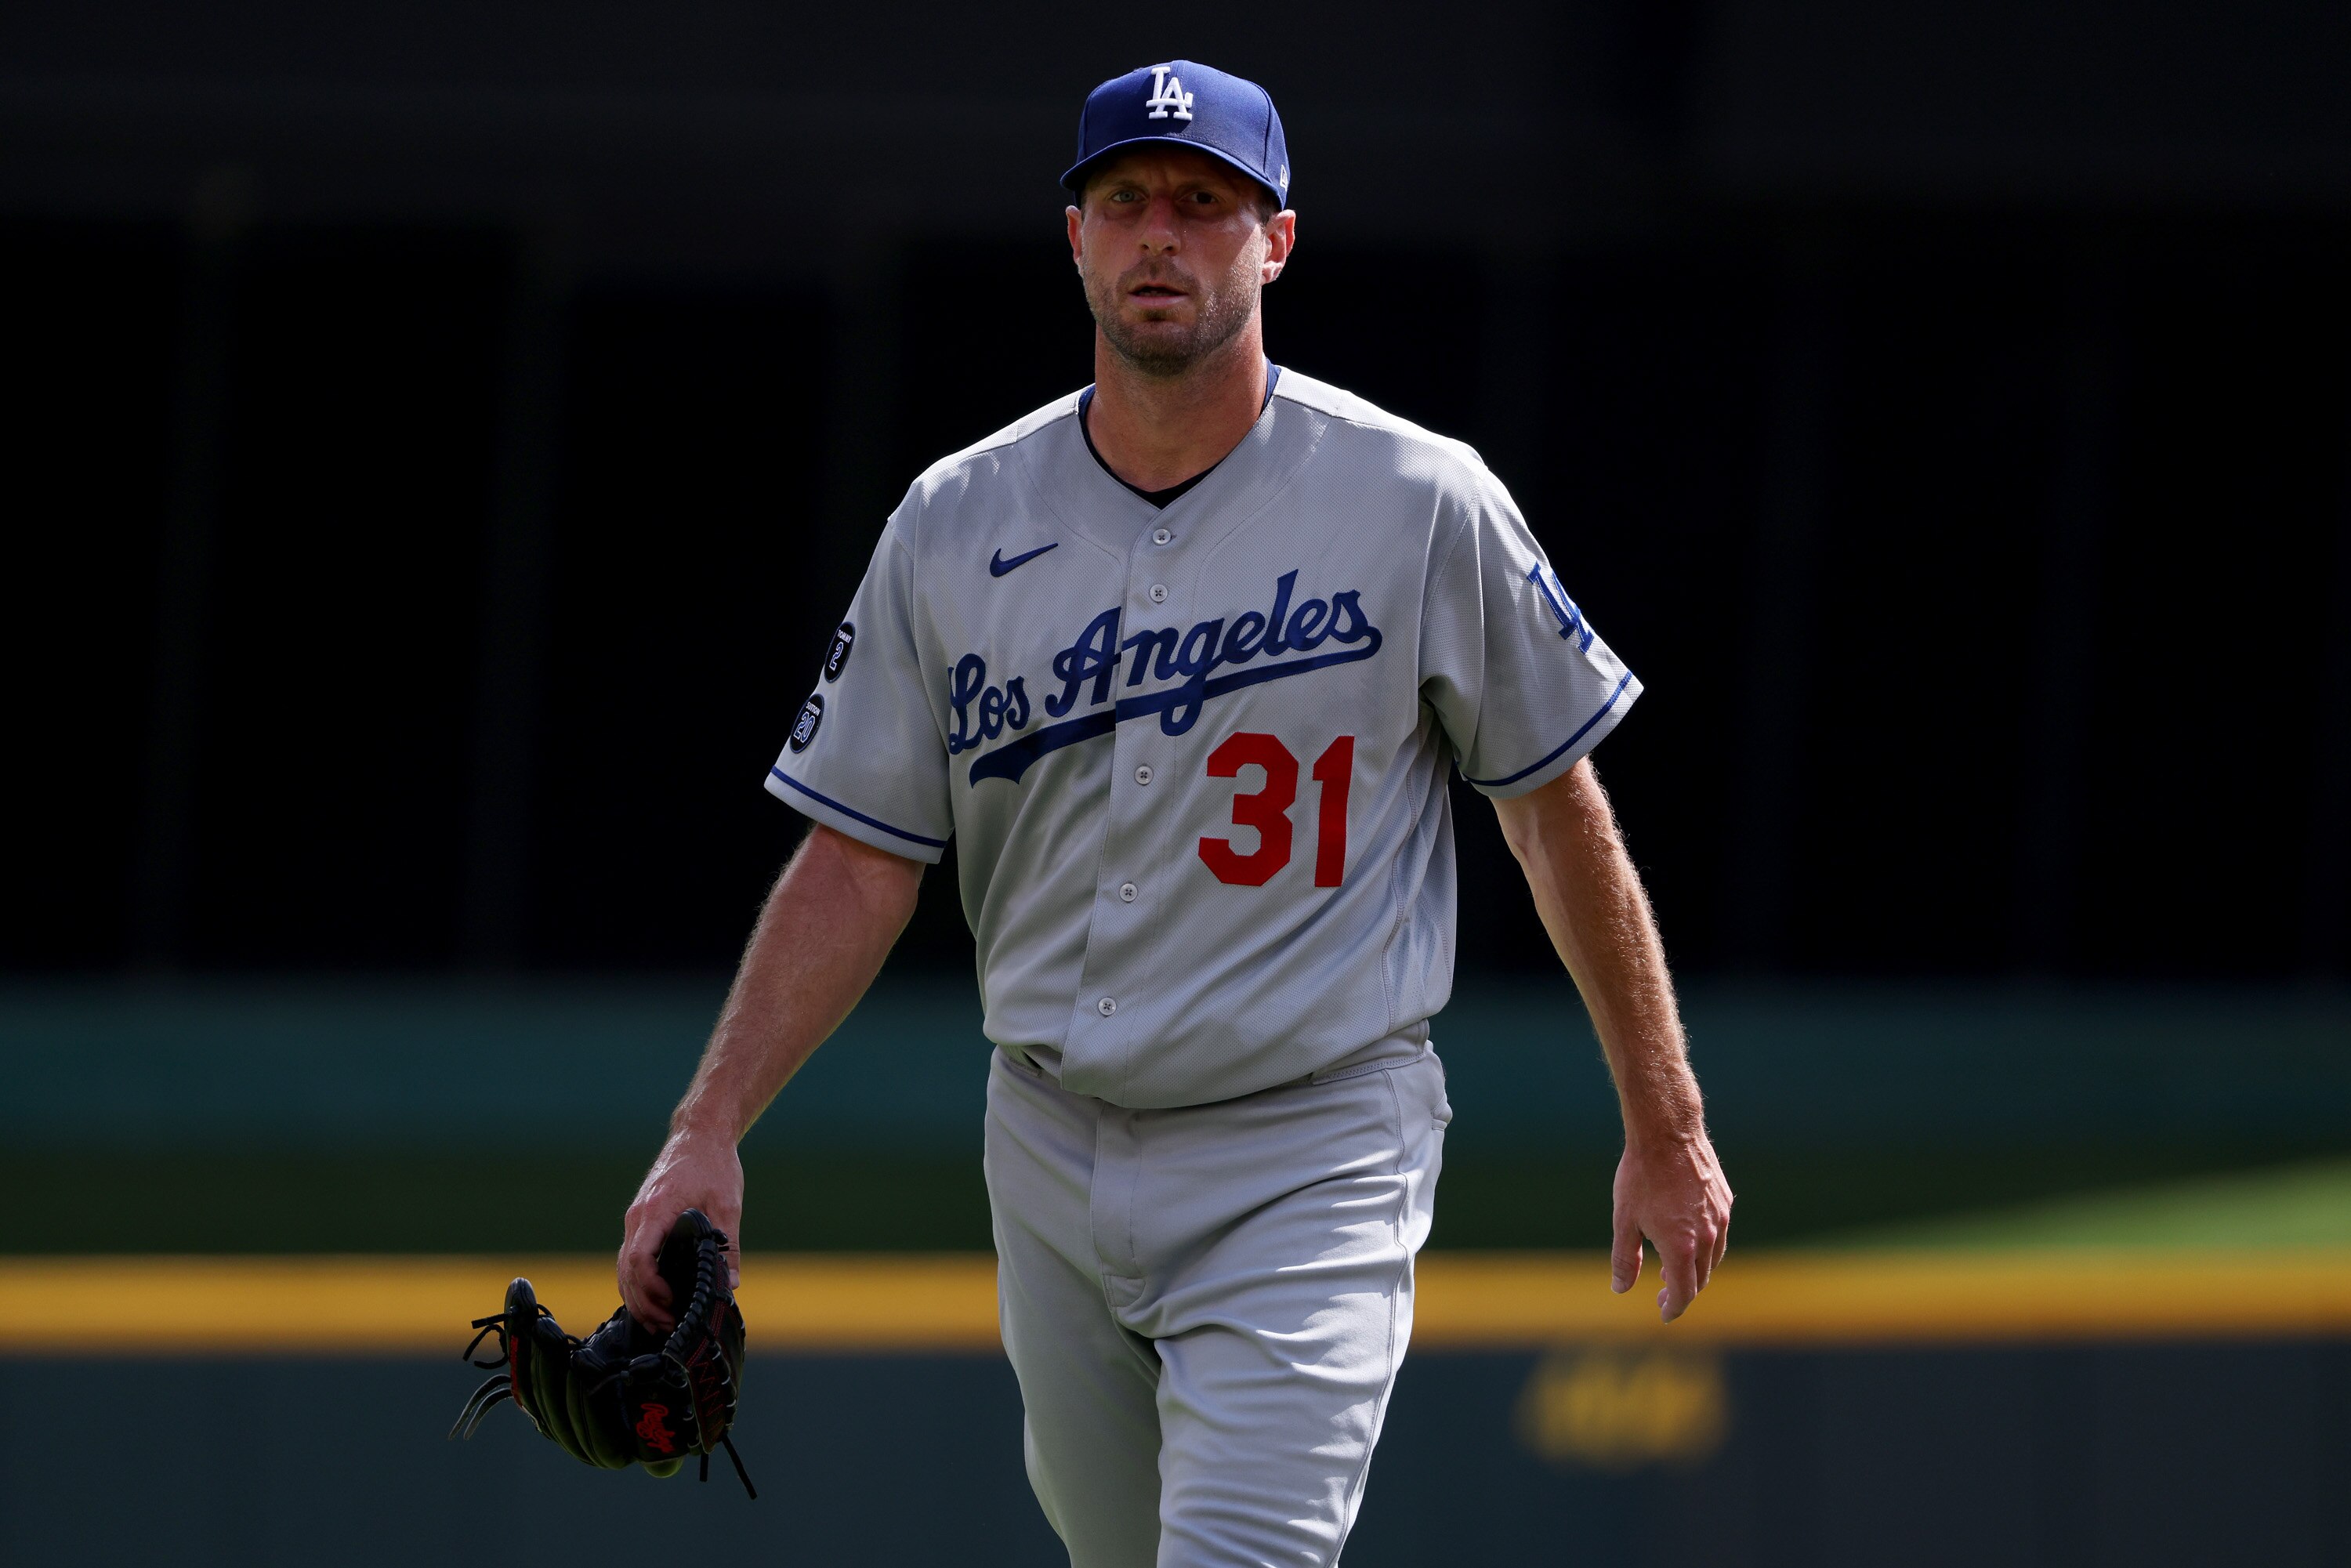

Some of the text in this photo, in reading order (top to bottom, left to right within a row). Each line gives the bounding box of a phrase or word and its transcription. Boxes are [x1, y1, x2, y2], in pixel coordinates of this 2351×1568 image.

[1146, 66, 1194, 121] LA
[830, 642, 843, 671] 2
[947, 569, 1382, 755] Los Angeles
[794, 712, 815, 743] 20
[806, 702, 820, 716] SUTTON
[1198, 731, 1355, 888] 31
